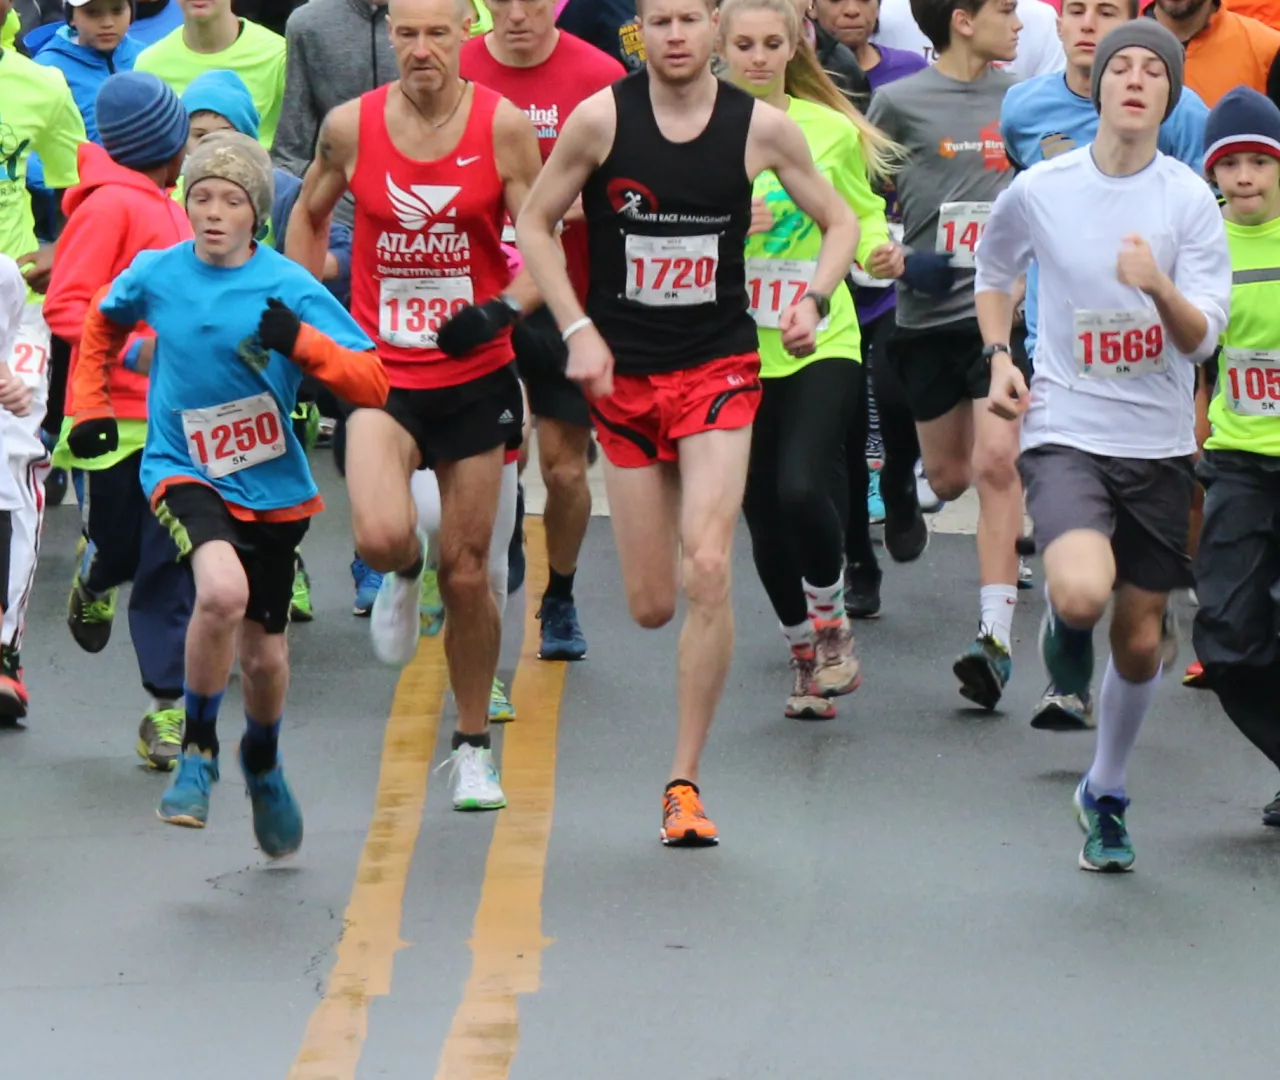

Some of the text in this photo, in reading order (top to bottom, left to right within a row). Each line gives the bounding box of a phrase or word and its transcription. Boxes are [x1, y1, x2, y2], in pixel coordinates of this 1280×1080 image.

[943, 141, 984, 152] Turkey
[376, 231, 470, 254] ATLANTA
[942, 220, 982, 253] 14
[376, 249, 470, 263] TRACK CLUB
[377, 264, 471, 277] COMPETITIVE TEAM
[630, 257, 715, 290] 1720
[748, 277, 810, 312] 117
[1079, 325, 1163, 365] 1569
[1261, 402, 1276, 411] 5K
[190, 412, 278, 464] 1250
[232, 453, 247, 465] 5K
